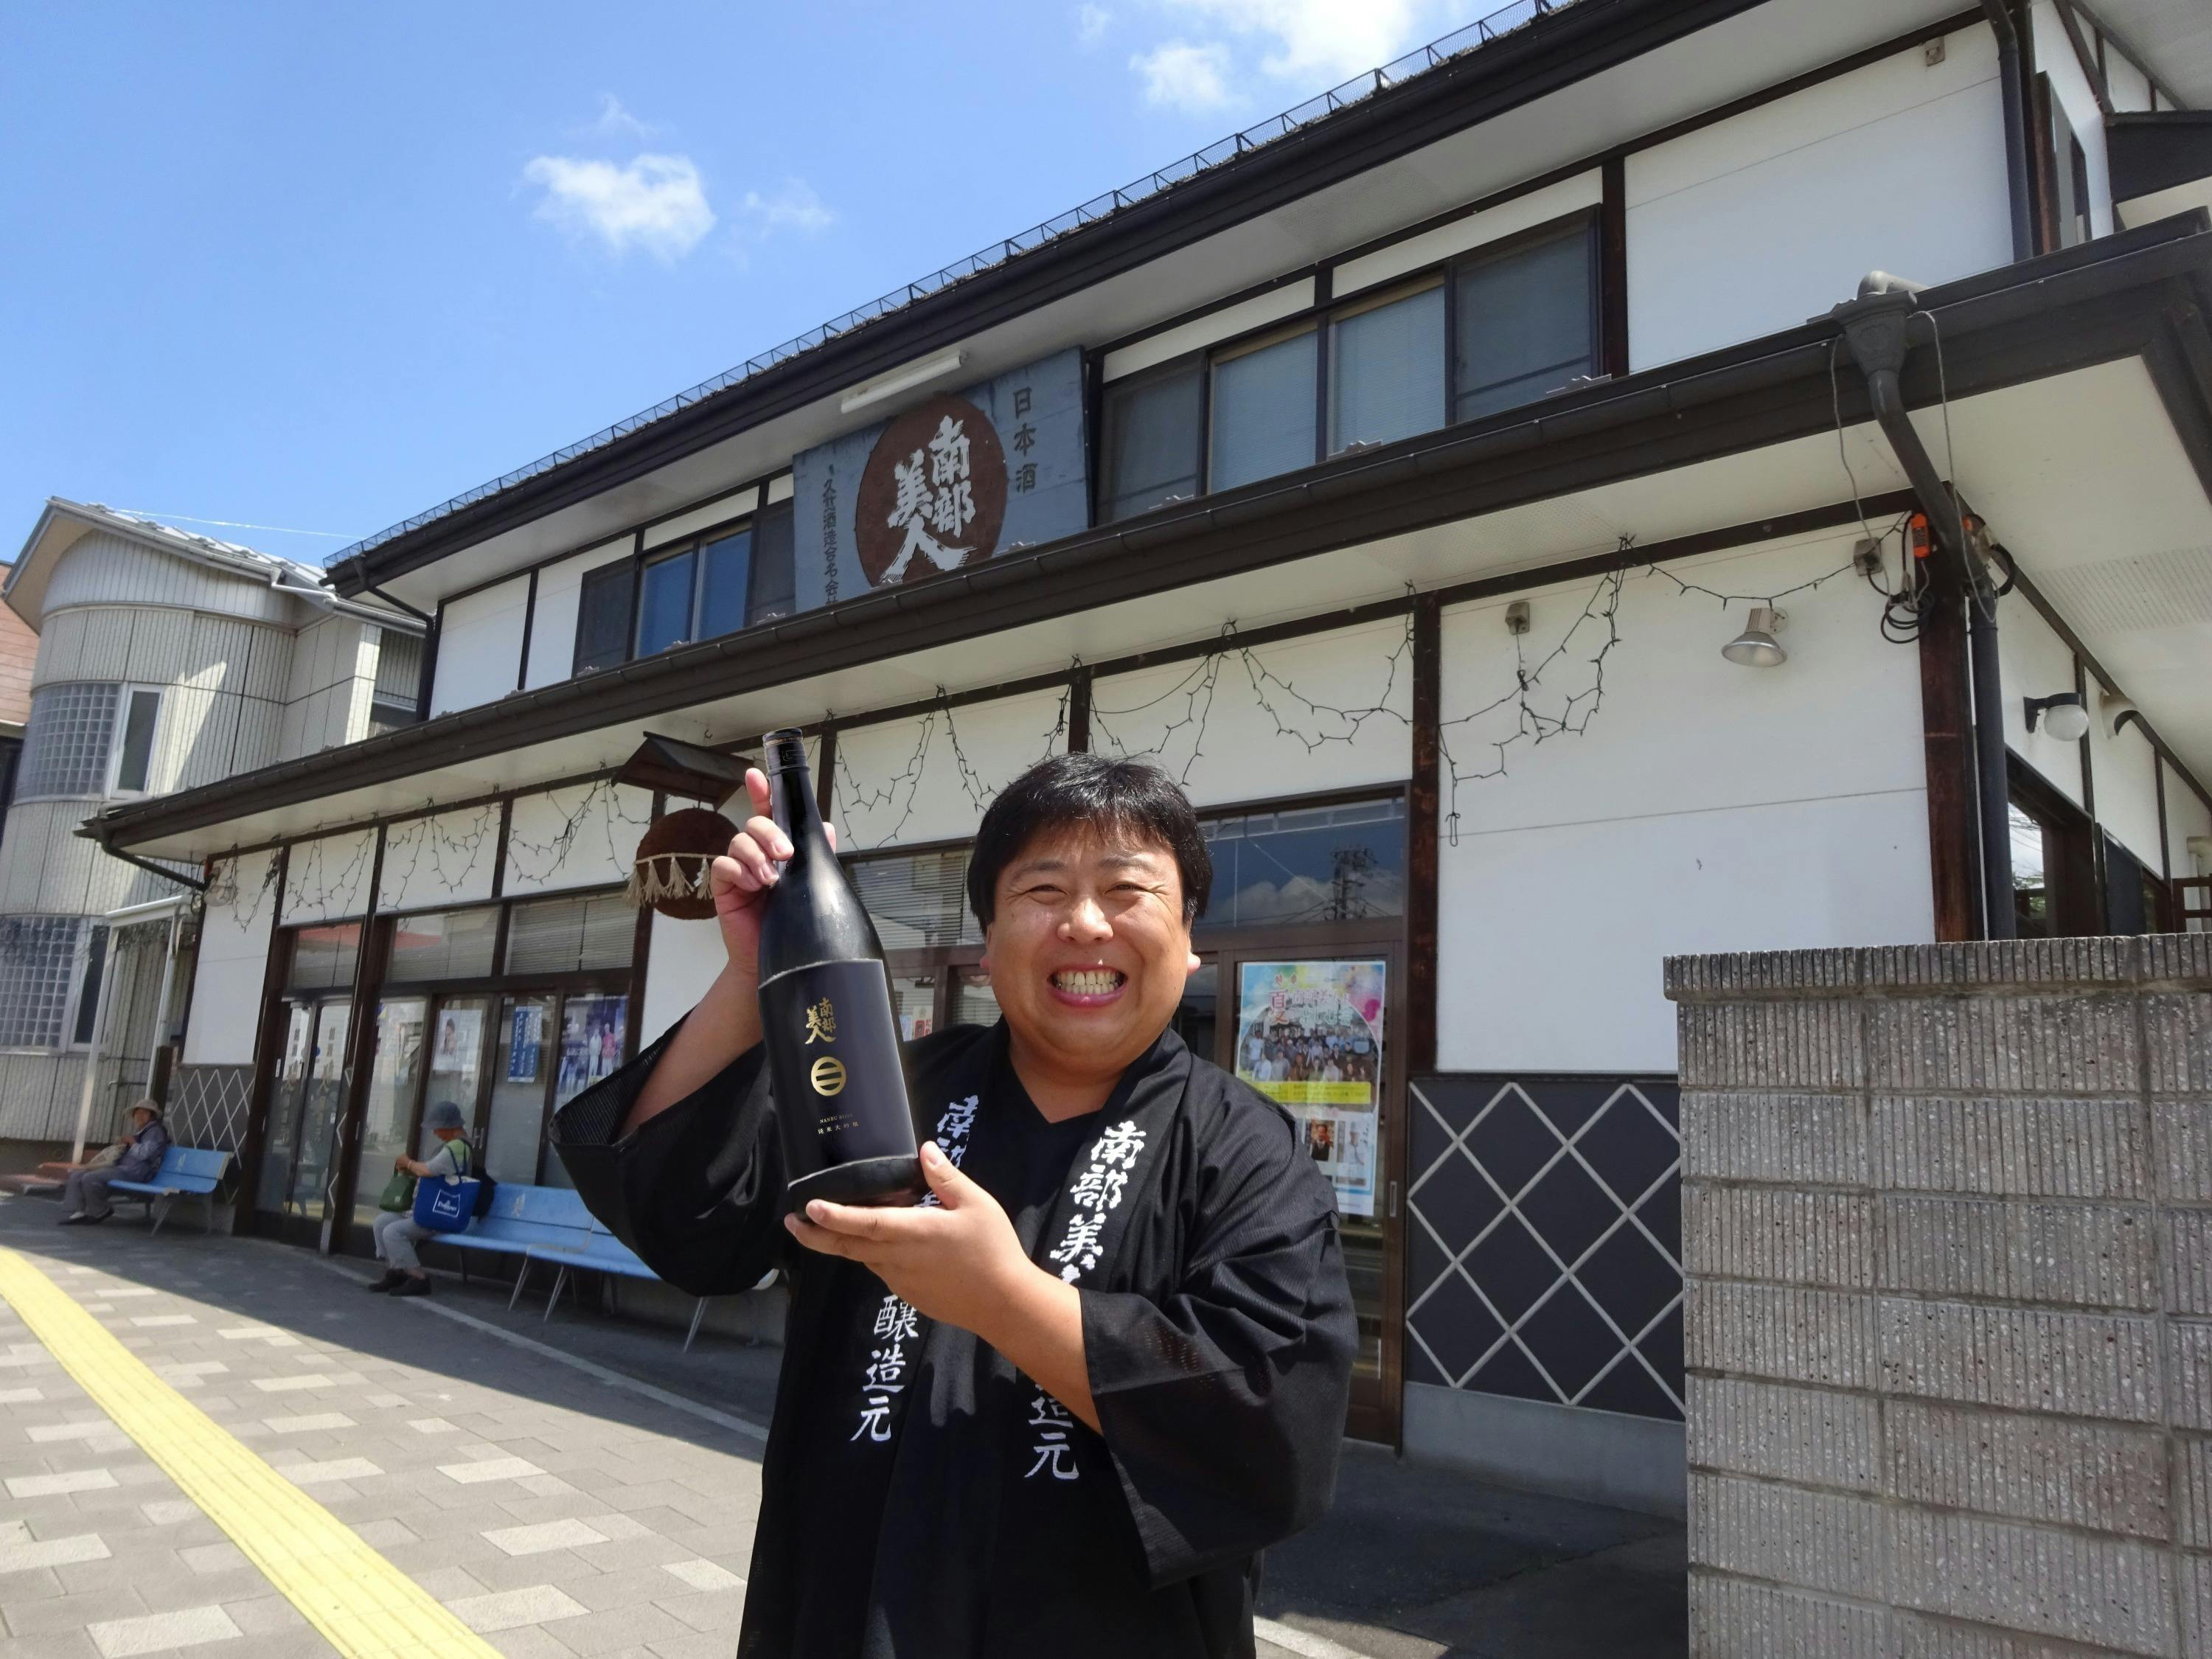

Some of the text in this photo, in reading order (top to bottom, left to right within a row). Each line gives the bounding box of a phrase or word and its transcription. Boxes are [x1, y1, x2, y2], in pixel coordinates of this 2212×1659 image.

[929, 414, 976, 538] 南部
[1013, 386, 1038, 494] 日本酒
[880, 448, 978, 583] 美人
[804, 1005, 837, 1045] 美人
[850, 1294, 919, 1441] 醸造元
